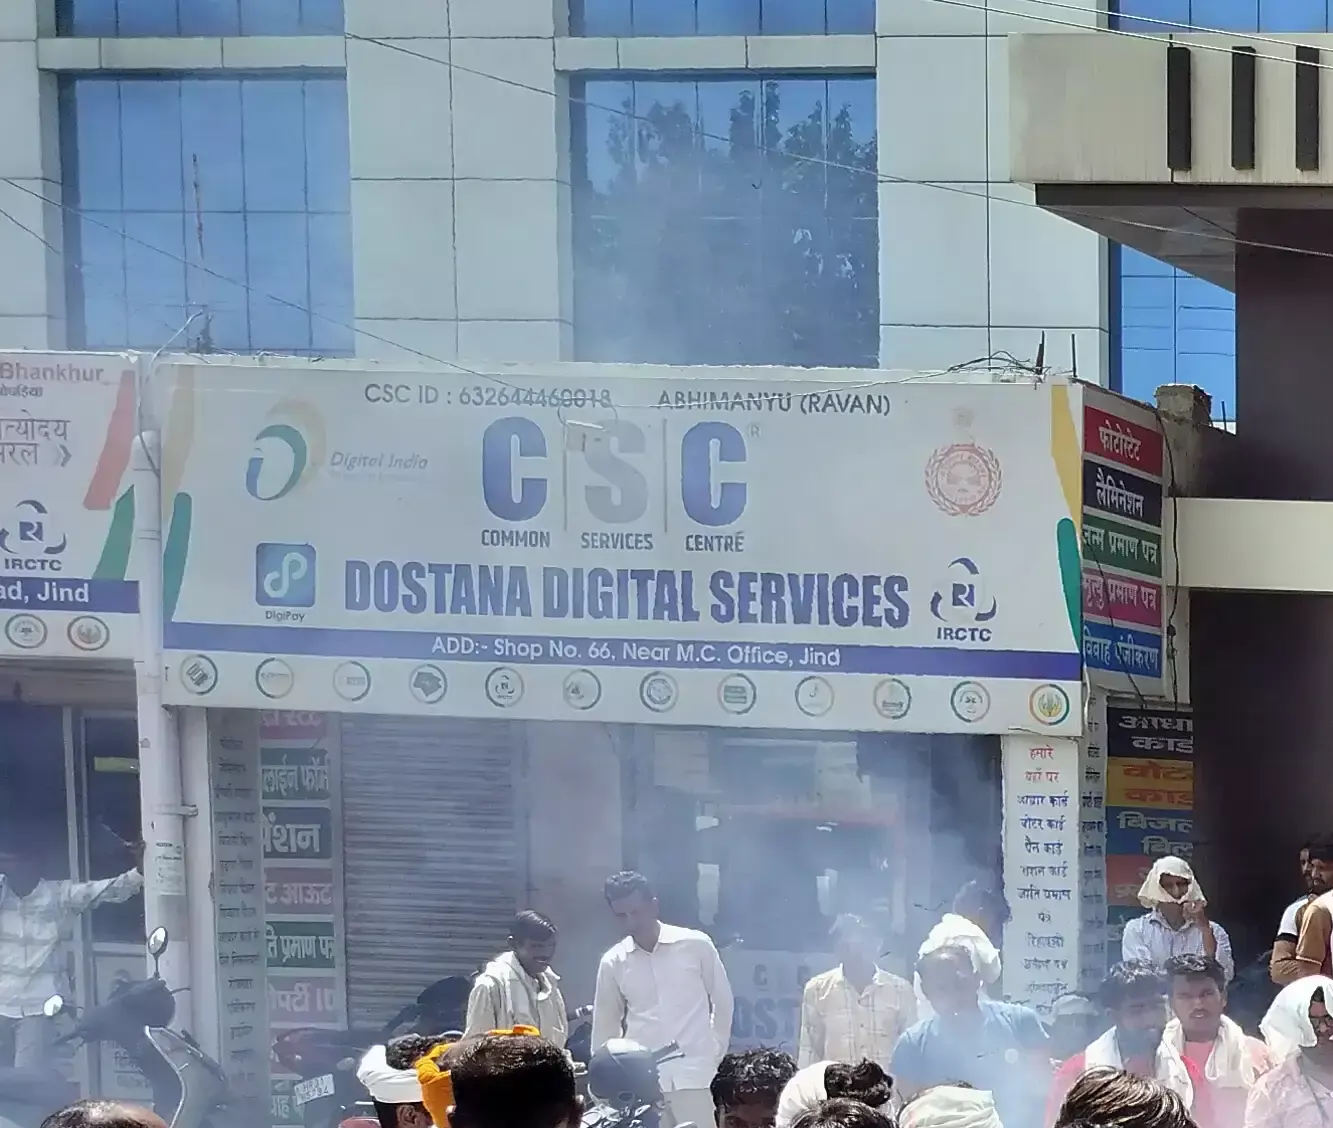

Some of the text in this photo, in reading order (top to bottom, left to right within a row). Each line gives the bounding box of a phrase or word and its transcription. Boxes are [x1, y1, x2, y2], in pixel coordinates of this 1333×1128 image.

[363, 383, 411, 404] CSC
[417, 384, 440, 404] ID
[656, 389, 891, 416] ABHIMANYU (RAVAN)
[330, 450, 429, 471] Digital India
[481, 529, 551, 548] COMMON
[581, 532, 654, 551] SERVICES
[4, 557, 63, 573] IRCTC
[36, 581, 91, 604] Jind
[345, 560, 911, 630] DOSTANA DIGITAL SERVICES
[936, 626, 993, 642] IRCTC
[493, 638, 544, 661] Shop
[547, 640, 583, 659] No.
[587, 644, 617, 661] 66,
[622, 645, 671, 663] Near
[675, 647, 722, 664] M.C.
[726, 645, 795, 668] Office,
[798, 647, 842, 668] Jind
